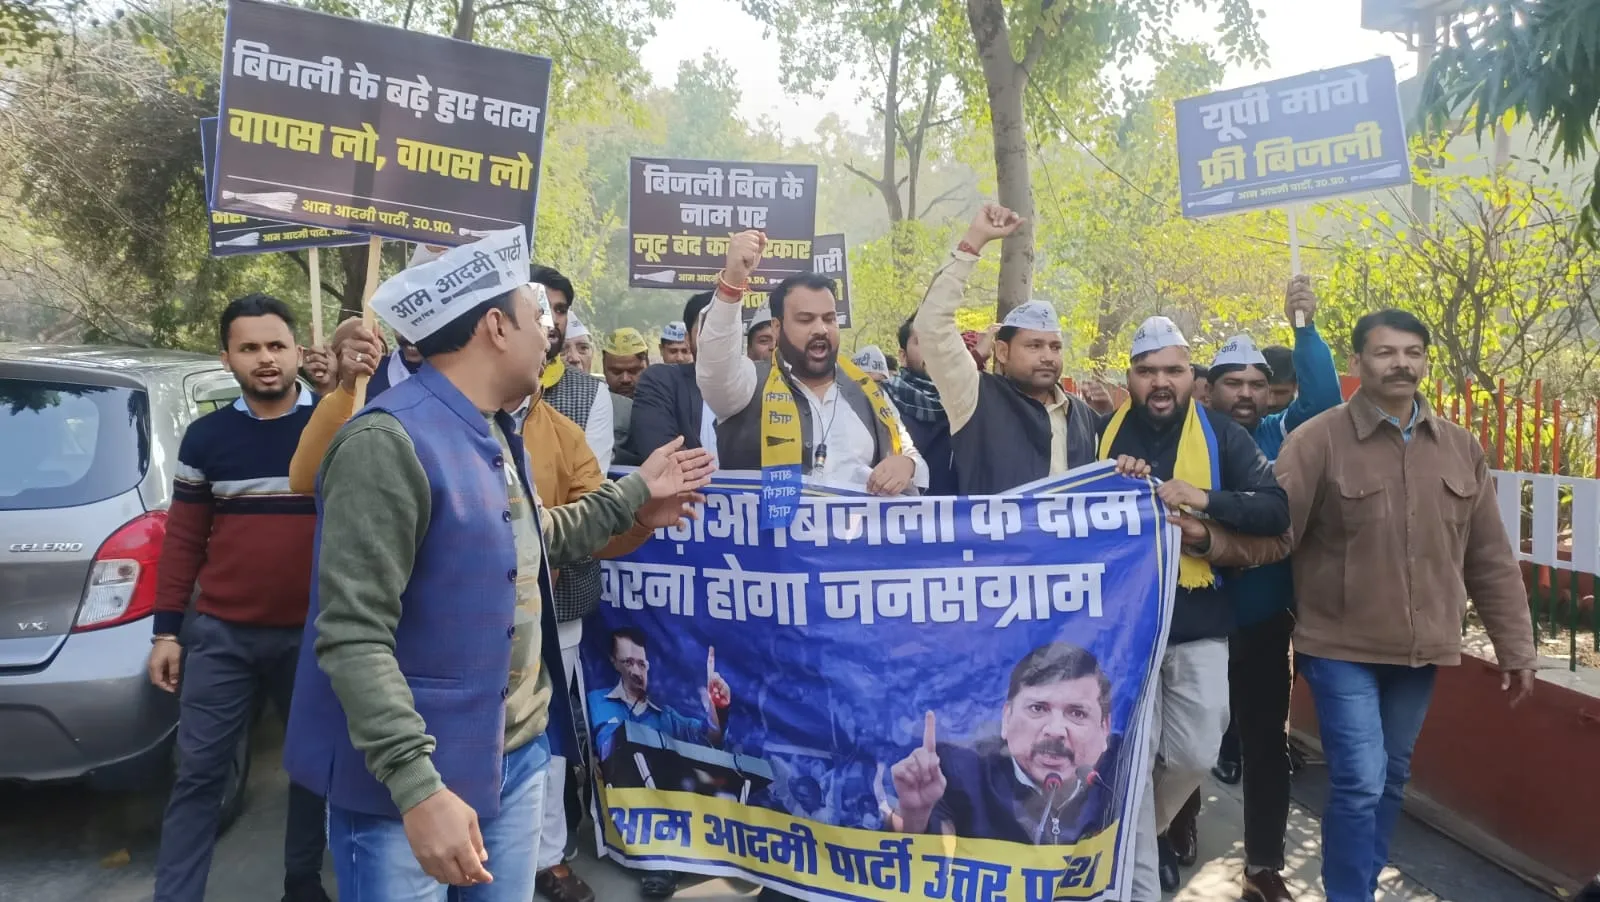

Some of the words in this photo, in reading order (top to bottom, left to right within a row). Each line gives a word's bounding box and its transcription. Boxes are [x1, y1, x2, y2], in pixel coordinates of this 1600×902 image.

[232, 38, 344, 96] बिजली
[349, 62, 380, 100] के
[386, 75, 432, 119] बढ़े
[436, 87, 479, 125] हुए
[483, 97, 541, 133] दाम
[1199, 87, 1271, 143] यूपी
[228, 108, 324, 154] वापस
[330, 122, 387, 172] लो,
[396, 137, 484, 183] वापस
[489, 152, 534, 191] लो
[1198, 145, 1247, 189] फ्री
[1253, 121, 1382, 178] बिजली
[643, 164, 724, 197] बिजली
[728, 168, 778, 199] बिल
[781, 171, 804, 200] के
[302, 199, 331, 216] आम
[333, 202, 377, 223] आदमी
[680, 203, 733, 227] नाम
[737, 205, 769, 229] पर
[633, 233, 668, 263] लूट
[672, 229, 702, 256] बंद
[761, 239, 812, 260] रकार
[813, 247, 843, 273] ारी
[390, 288, 432, 320] आम
[435, 250, 498, 294] आदमी
[1034, 489, 1143, 538] दाम
[9, 542, 84, 552] CELERIO
[600, 559, 695, 617] वरना
[703, 553, 809, 625] होगा
[820, 550, 1106, 628] जनसंग्राम
[608, 806, 693, 848] आम
[703, 813, 819, 876] आदमी
[824, 837, 914, 894] पार्टी
[921, 854, 1012, 902] उत्तर
